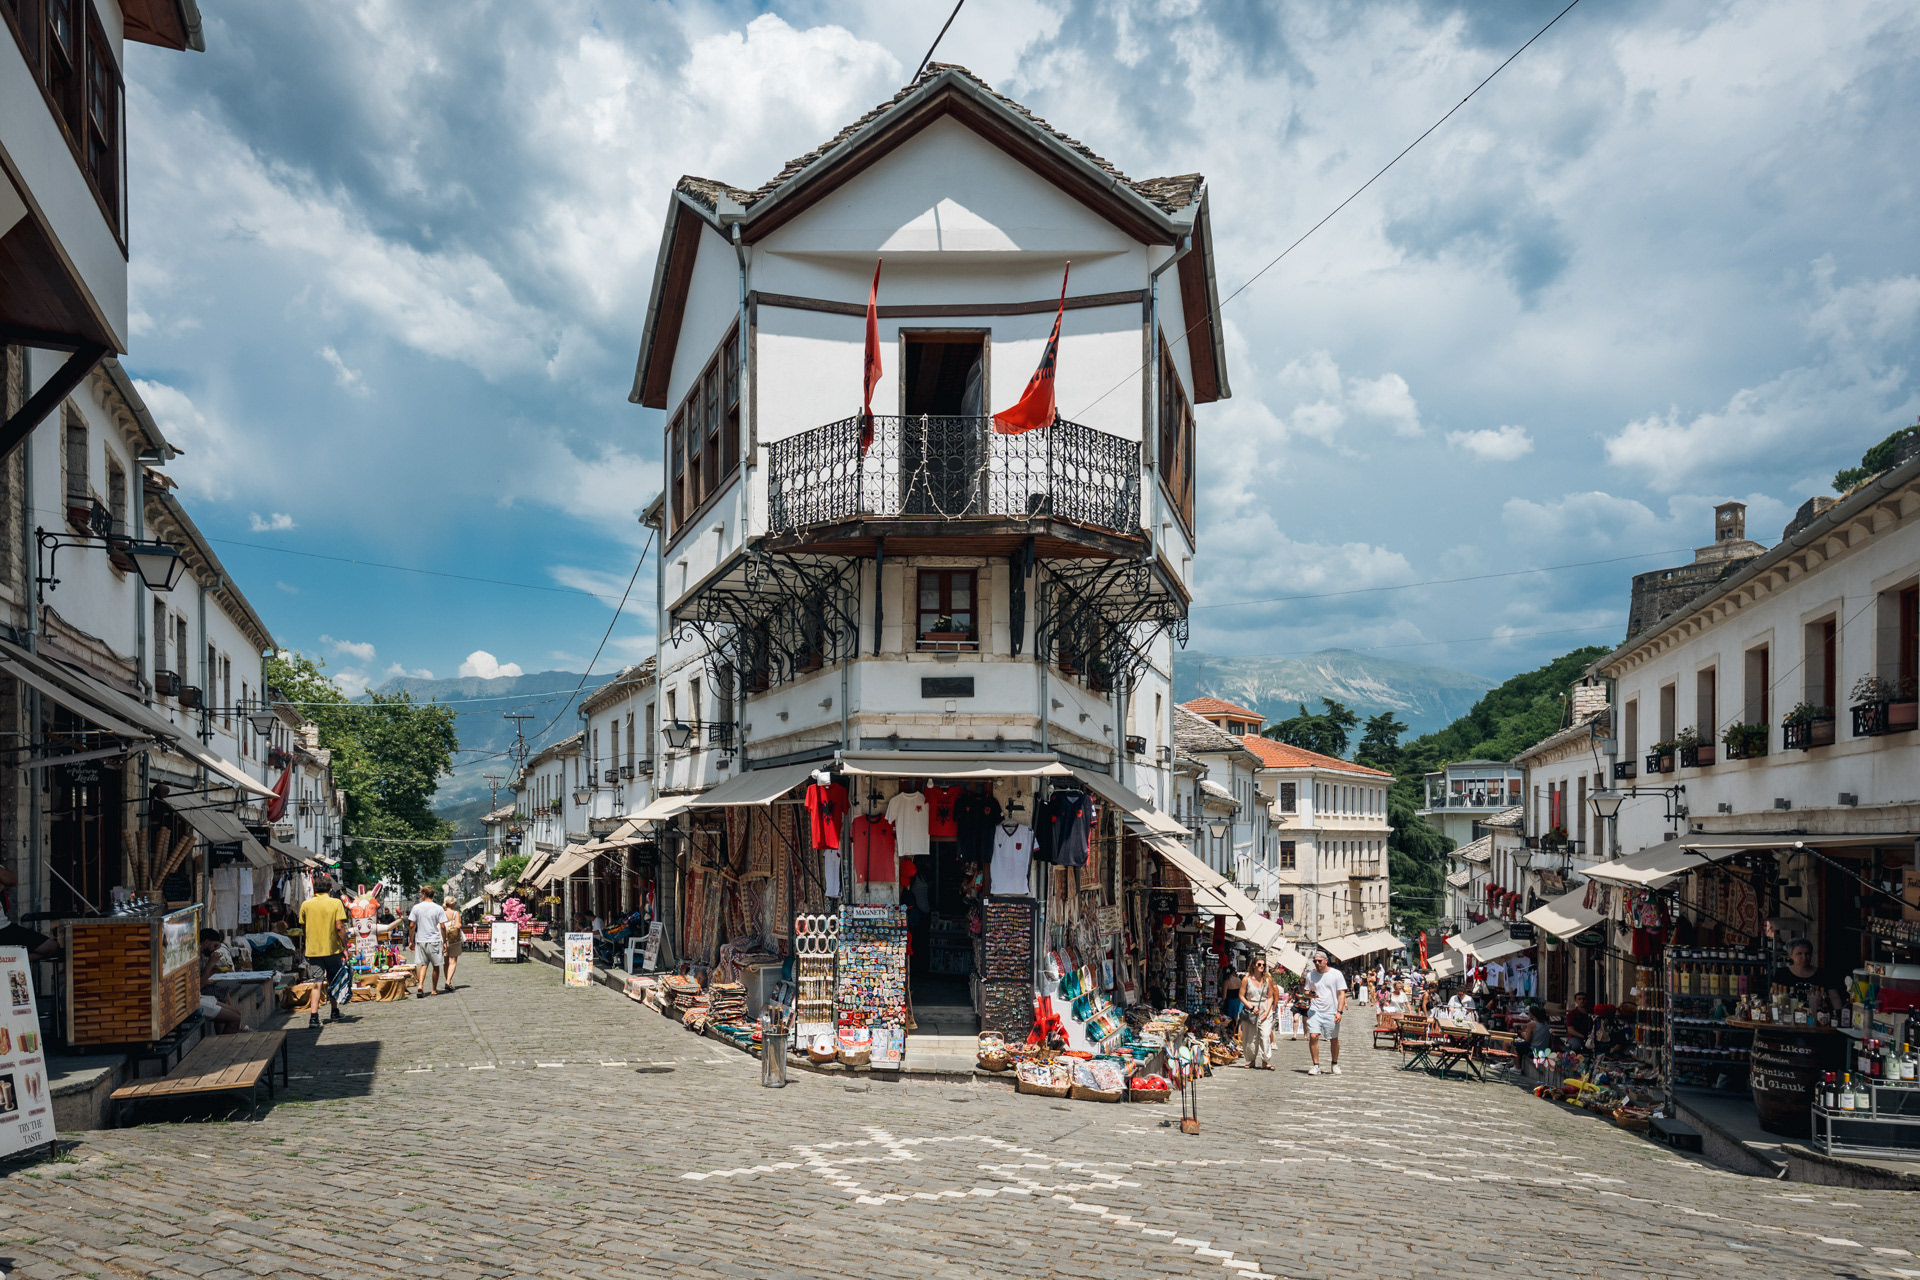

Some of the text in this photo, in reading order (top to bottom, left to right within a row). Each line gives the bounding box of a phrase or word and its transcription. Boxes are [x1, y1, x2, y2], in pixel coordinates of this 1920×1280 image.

[1780, 1044, 1812, 1055] Liker
[1753, 1065, 1796, 1078] Botanikal
[1769, 1080, 1806, 1092] Glauk
[18, 1119, 43, 1133] TRY THE
[23, 1131, 43, 1144] TASTE
